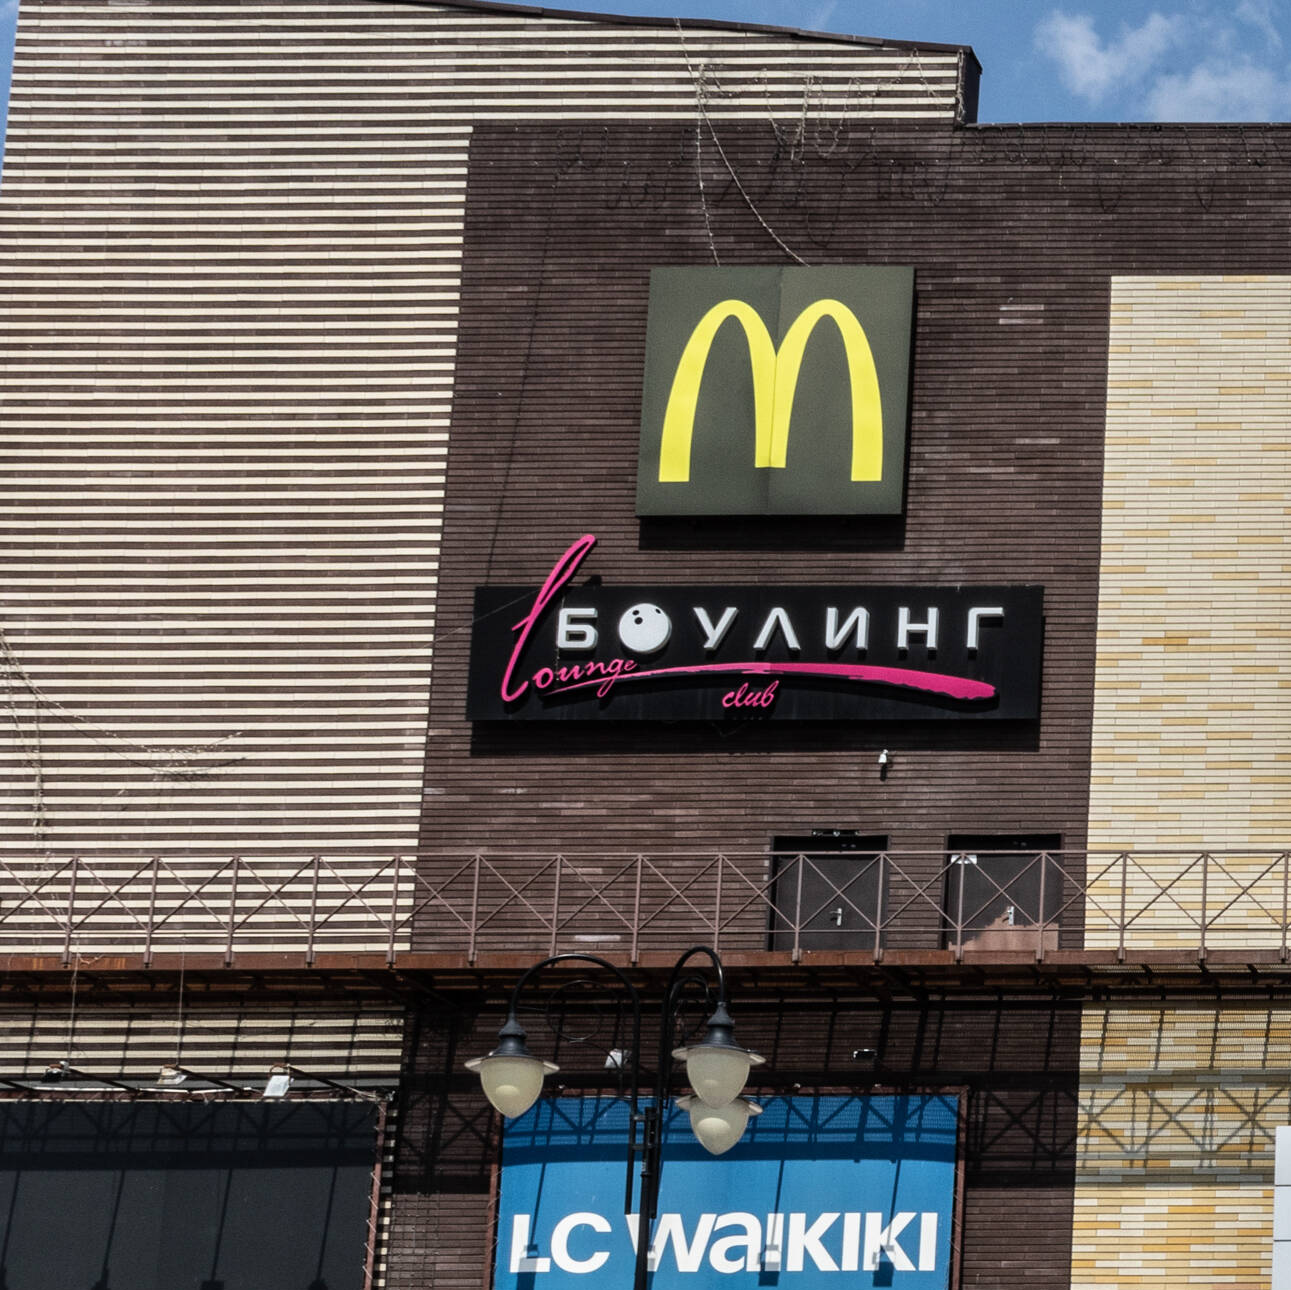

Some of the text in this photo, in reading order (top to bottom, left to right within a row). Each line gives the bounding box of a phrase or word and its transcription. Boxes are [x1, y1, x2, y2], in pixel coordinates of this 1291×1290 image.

[556, 603, 1005, 652] БОУЛИНГ
[722, 681, 780, 708] club
[510, 1212, 612, 1274] LC
